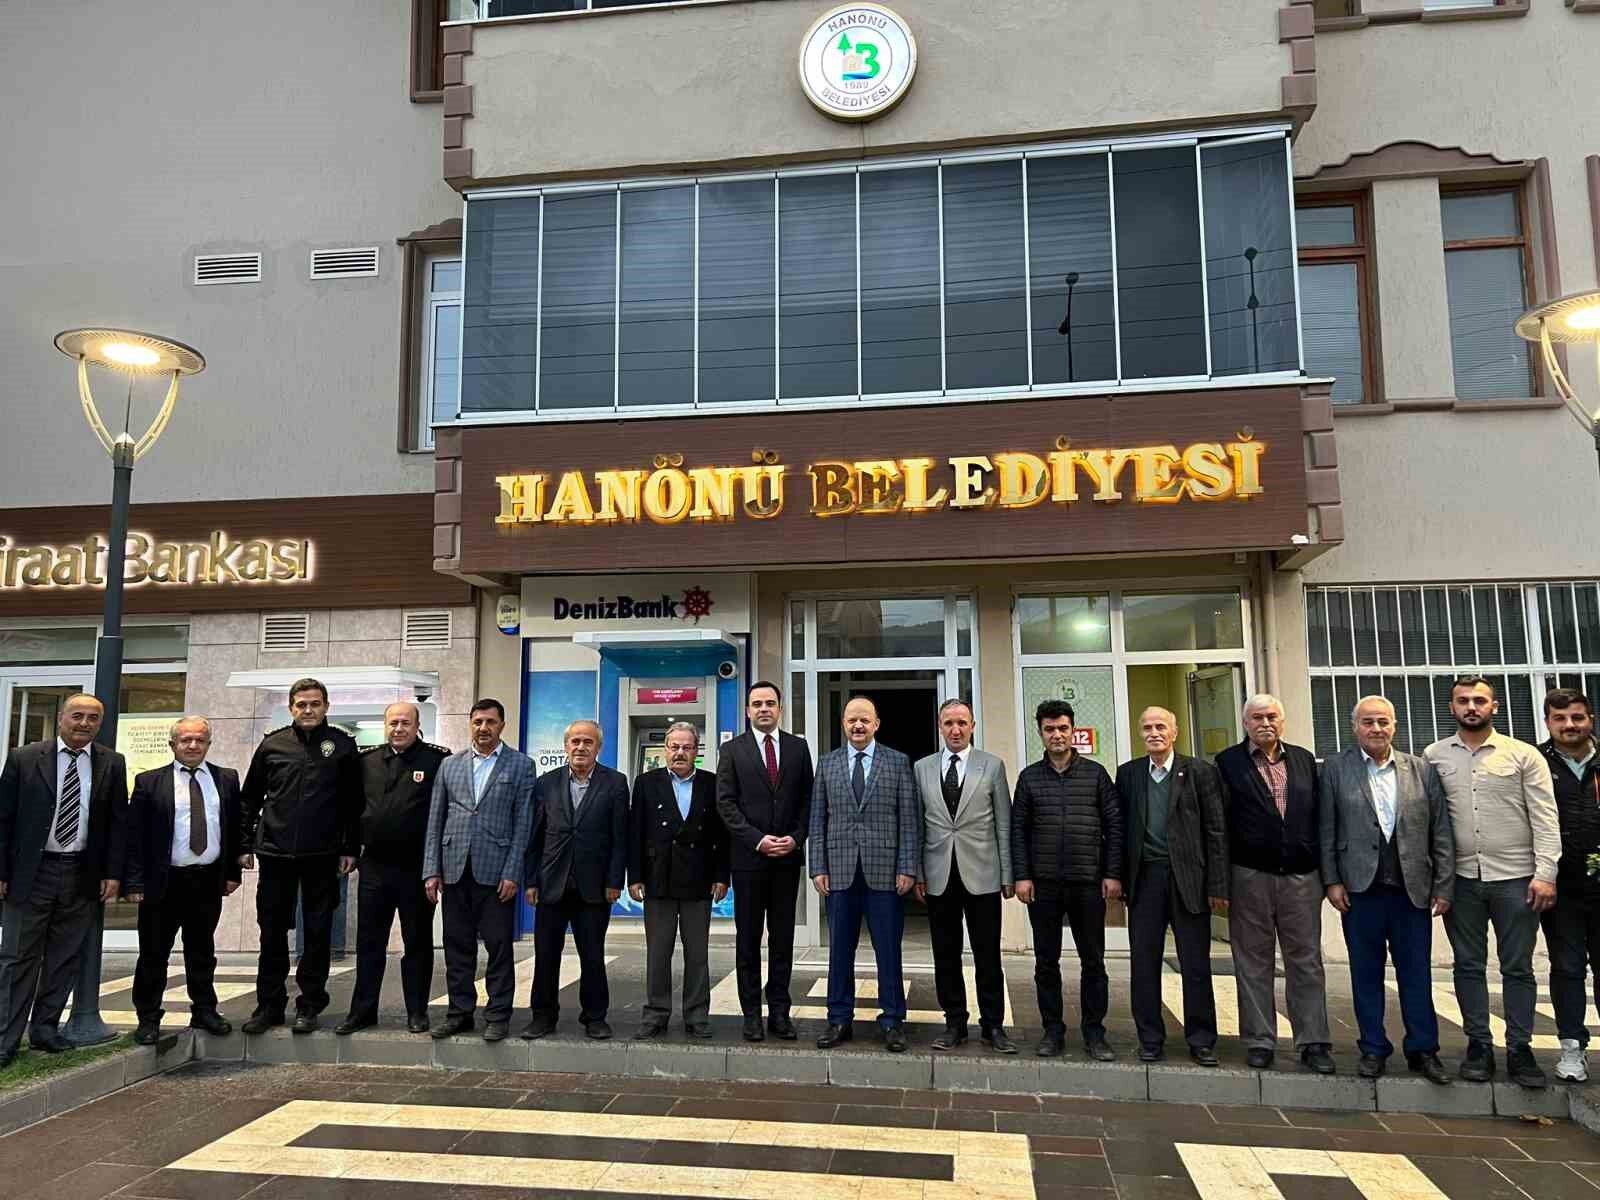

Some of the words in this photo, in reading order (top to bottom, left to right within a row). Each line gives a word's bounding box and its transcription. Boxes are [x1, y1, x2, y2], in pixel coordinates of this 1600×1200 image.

[495, 449, 785, 525] HANÖNÜ
[807, 425, 1265, 516] BELEDİYESİ
[121, 530, 309, 584] Bankası
[553, 593, 681, 620] DenizBank
